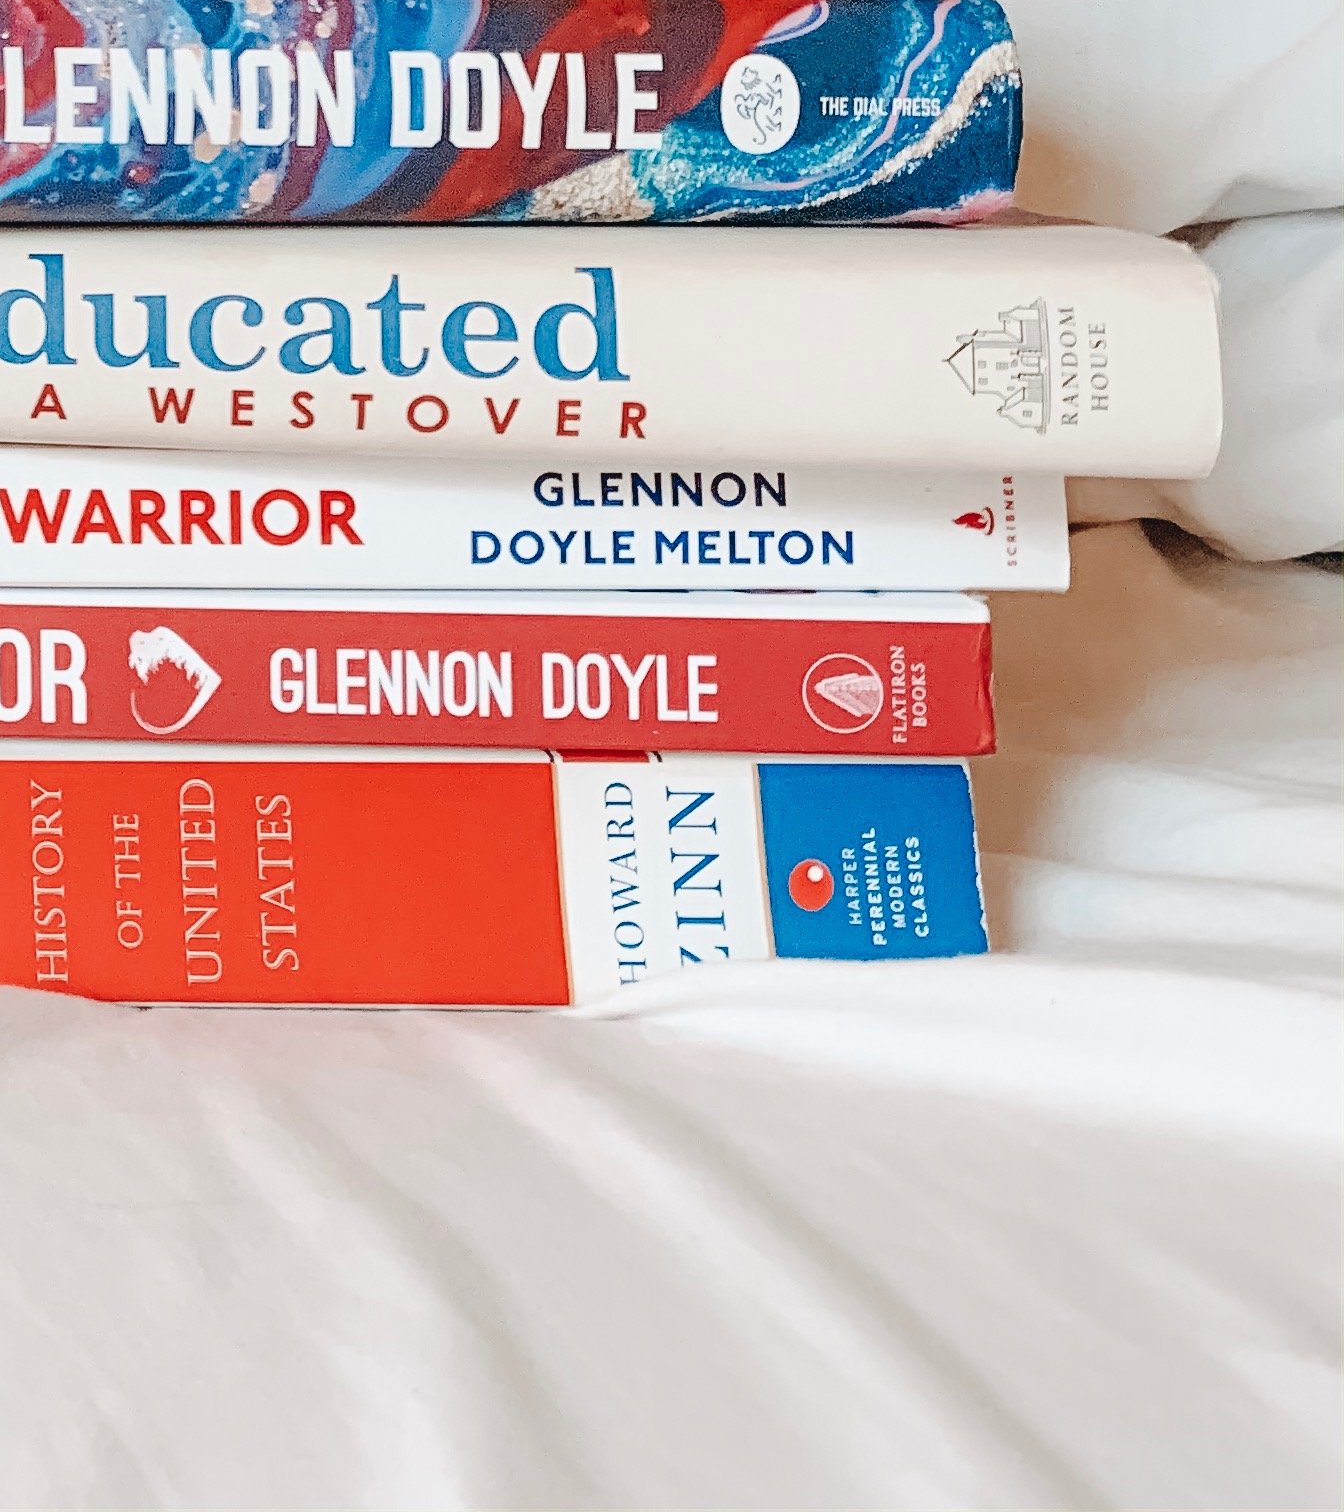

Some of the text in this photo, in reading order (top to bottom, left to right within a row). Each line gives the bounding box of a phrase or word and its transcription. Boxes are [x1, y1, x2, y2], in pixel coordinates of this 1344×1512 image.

[390, 51, 664, 151] DOYLE
[819, 96, 941, 117] THE DIAL PRESS
[149, 388, 647, 439] WESTOVER
[1057, 306, 1079, 426] RANDOM
[1089, 322, 1109, 411] HOUSE
[534, 472, 785, 508] GLENNON
[1002, 475, 1018, 567] SCRIBNER
[470, 530, 854, 565] DOYLE MELTON
[270, 647, 719, 723] GLENNON DOYLE
[890, 645, 907, 744] FLATIRON
[911, 662, 927, 727] BOOKS
[30, 779, 69, 983] HISTORY
[113, 812, 143, 949] OF THE
[179, 779, 222, 986] UNITED
[254, 792, 299, 972] STATES
[604, 782, 647, 985] HOWARD
[842, 848, 862, 925] HARPER
[862, 828, 887, 945] PERENNIAL
[884, 846, 906, 928] MODERN
[905, 836, 929, 937] CLASSICS
